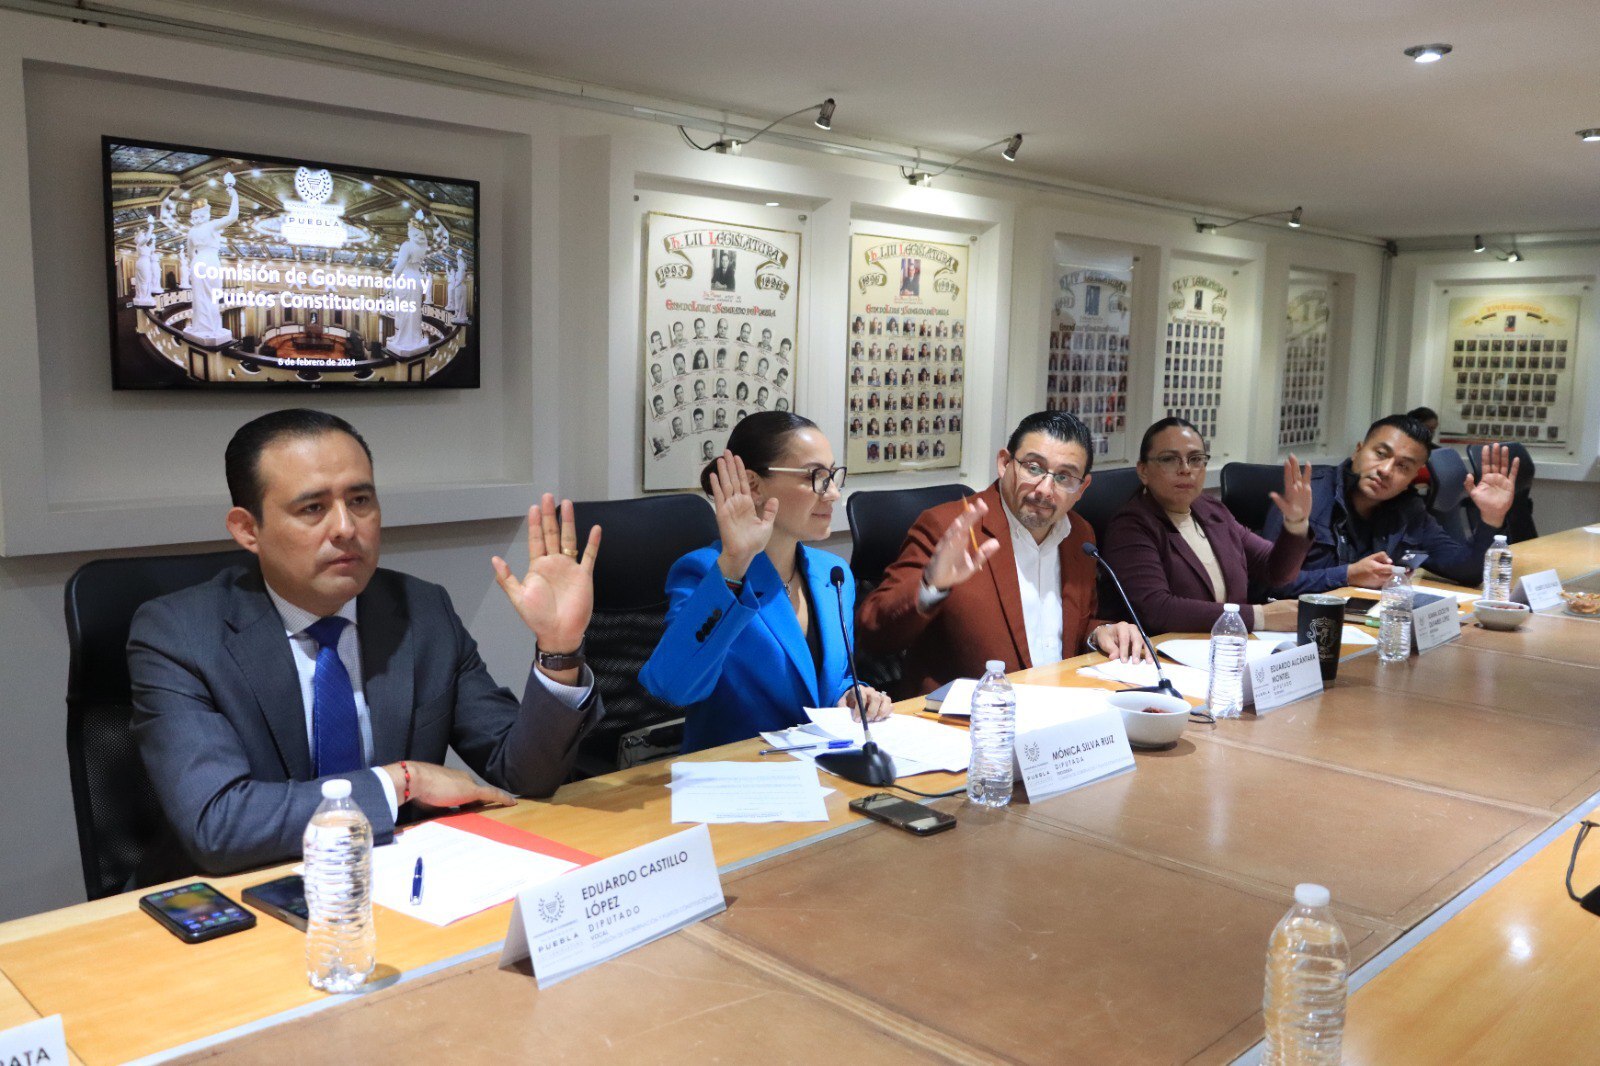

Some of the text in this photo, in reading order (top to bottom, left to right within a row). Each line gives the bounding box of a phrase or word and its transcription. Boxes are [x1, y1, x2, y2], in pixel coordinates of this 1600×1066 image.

[289, 217, 339, 227] PUEBLA
[193, 262, 430, 294] Comisión de Gobernación y
[212, 288, 417, 313] Puntos Constitucionales
[278, 357, 356, 366] 6 de febrero de 2024
[1270, 660, 1291, 673] EDUARDO
[1291, 653, 1316, 666] ALCÁNTARA
[1052, 734, 1115, 761] MÓNICA SILVA RUIZ
[1055, 756, 1084, 770] DIPUTADA
[581, 850, 688, 900] EDUARDO CASTILLO
[585, 895, 620, 919] LÓPEZ
[588, 905, 640, 933] DIPUTADO
[538, 932, 579, 952] PUEBLA
[591, 930, 609, 941] VOCAL
